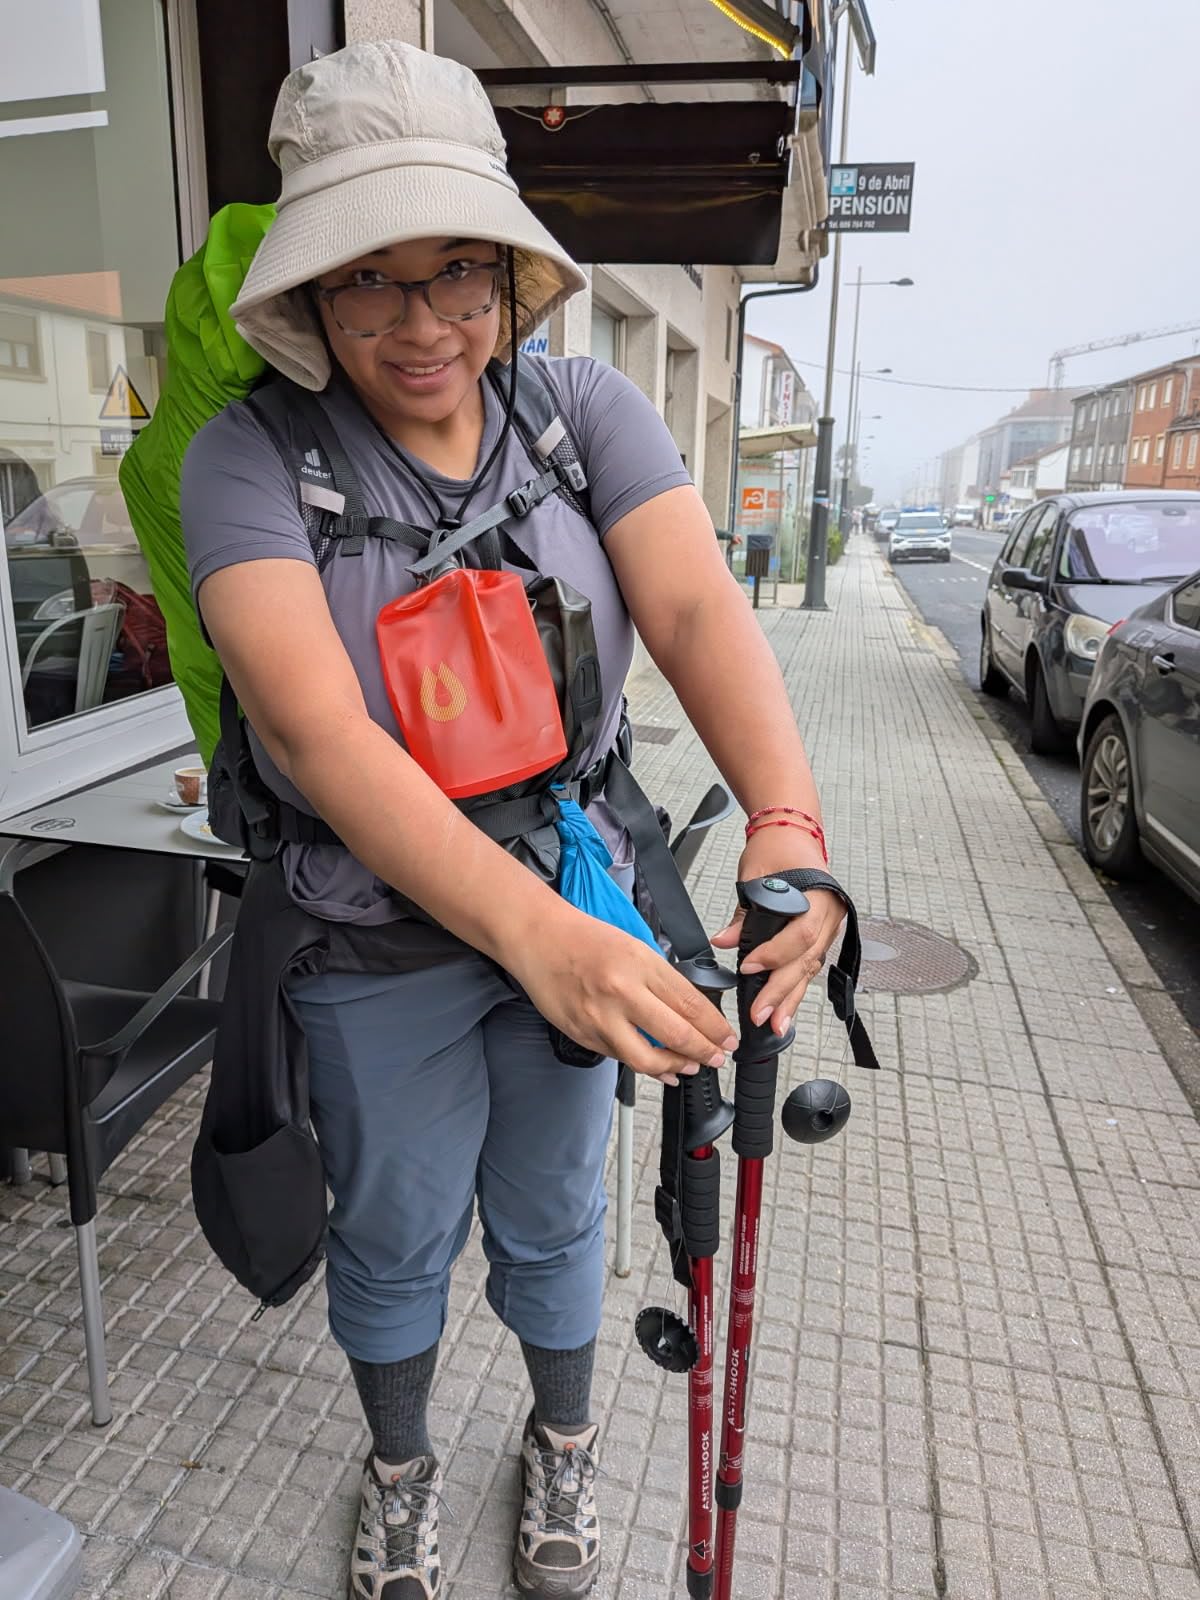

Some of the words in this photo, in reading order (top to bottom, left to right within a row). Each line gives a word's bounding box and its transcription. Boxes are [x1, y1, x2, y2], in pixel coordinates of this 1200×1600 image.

[858, 176, 867, 191] 9
[868, 175, 882, 190] de
[884, 174, 911, 190] Abril
[829, 192, 910, 216] PENSIÓN
[301, 464, 332, 480] deuter
